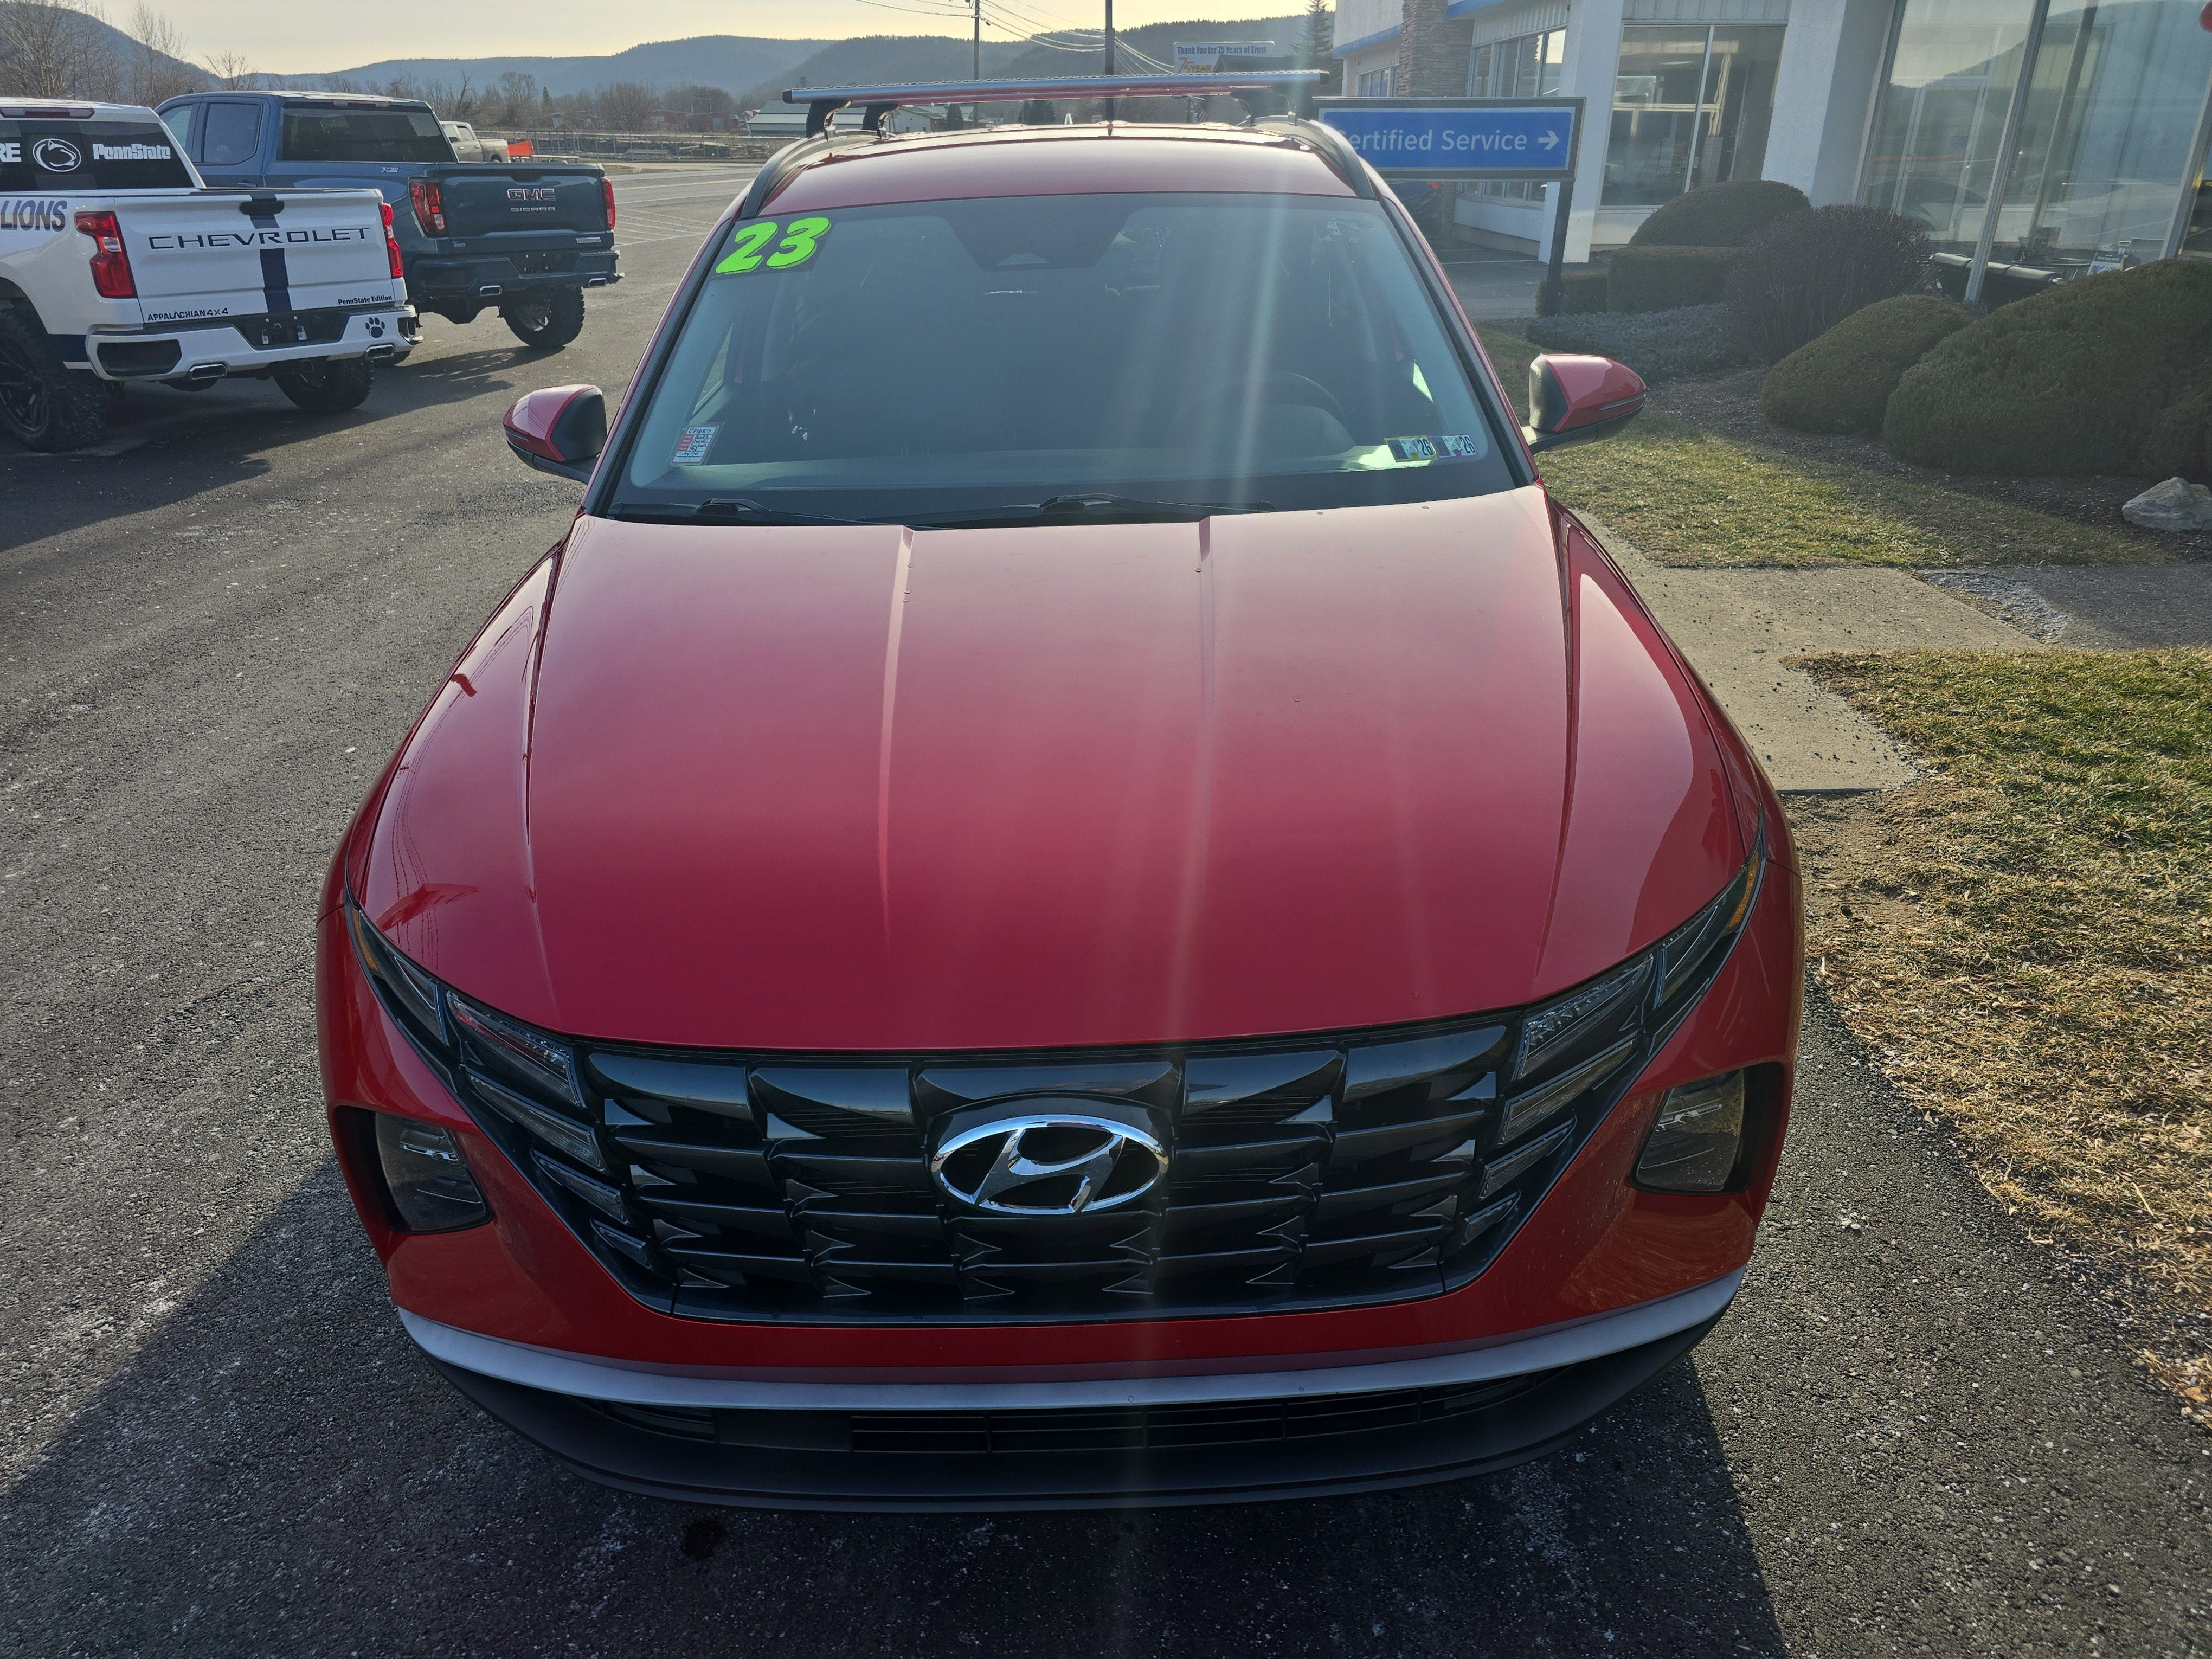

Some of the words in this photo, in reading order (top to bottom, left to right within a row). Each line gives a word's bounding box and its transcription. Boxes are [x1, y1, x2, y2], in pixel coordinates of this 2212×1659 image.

[1177, 46, 1195, 54] Thank
[1244, 46, 1250, 54] of
[1251, 46, 1266, 54] Trust
[1338, 129, 1433, 150] ertified
[1441, 130, 1528, 150] Service
[507, 188, 555, 201] GMC
[0, 200, 68, 232] LIONS
[149, 227, 370, 249] CHEVROLET
[716, 217, 830, 275] 23
[1417, 439, 1433, 455] 26
[1459, 436, 1475, 453] 26
